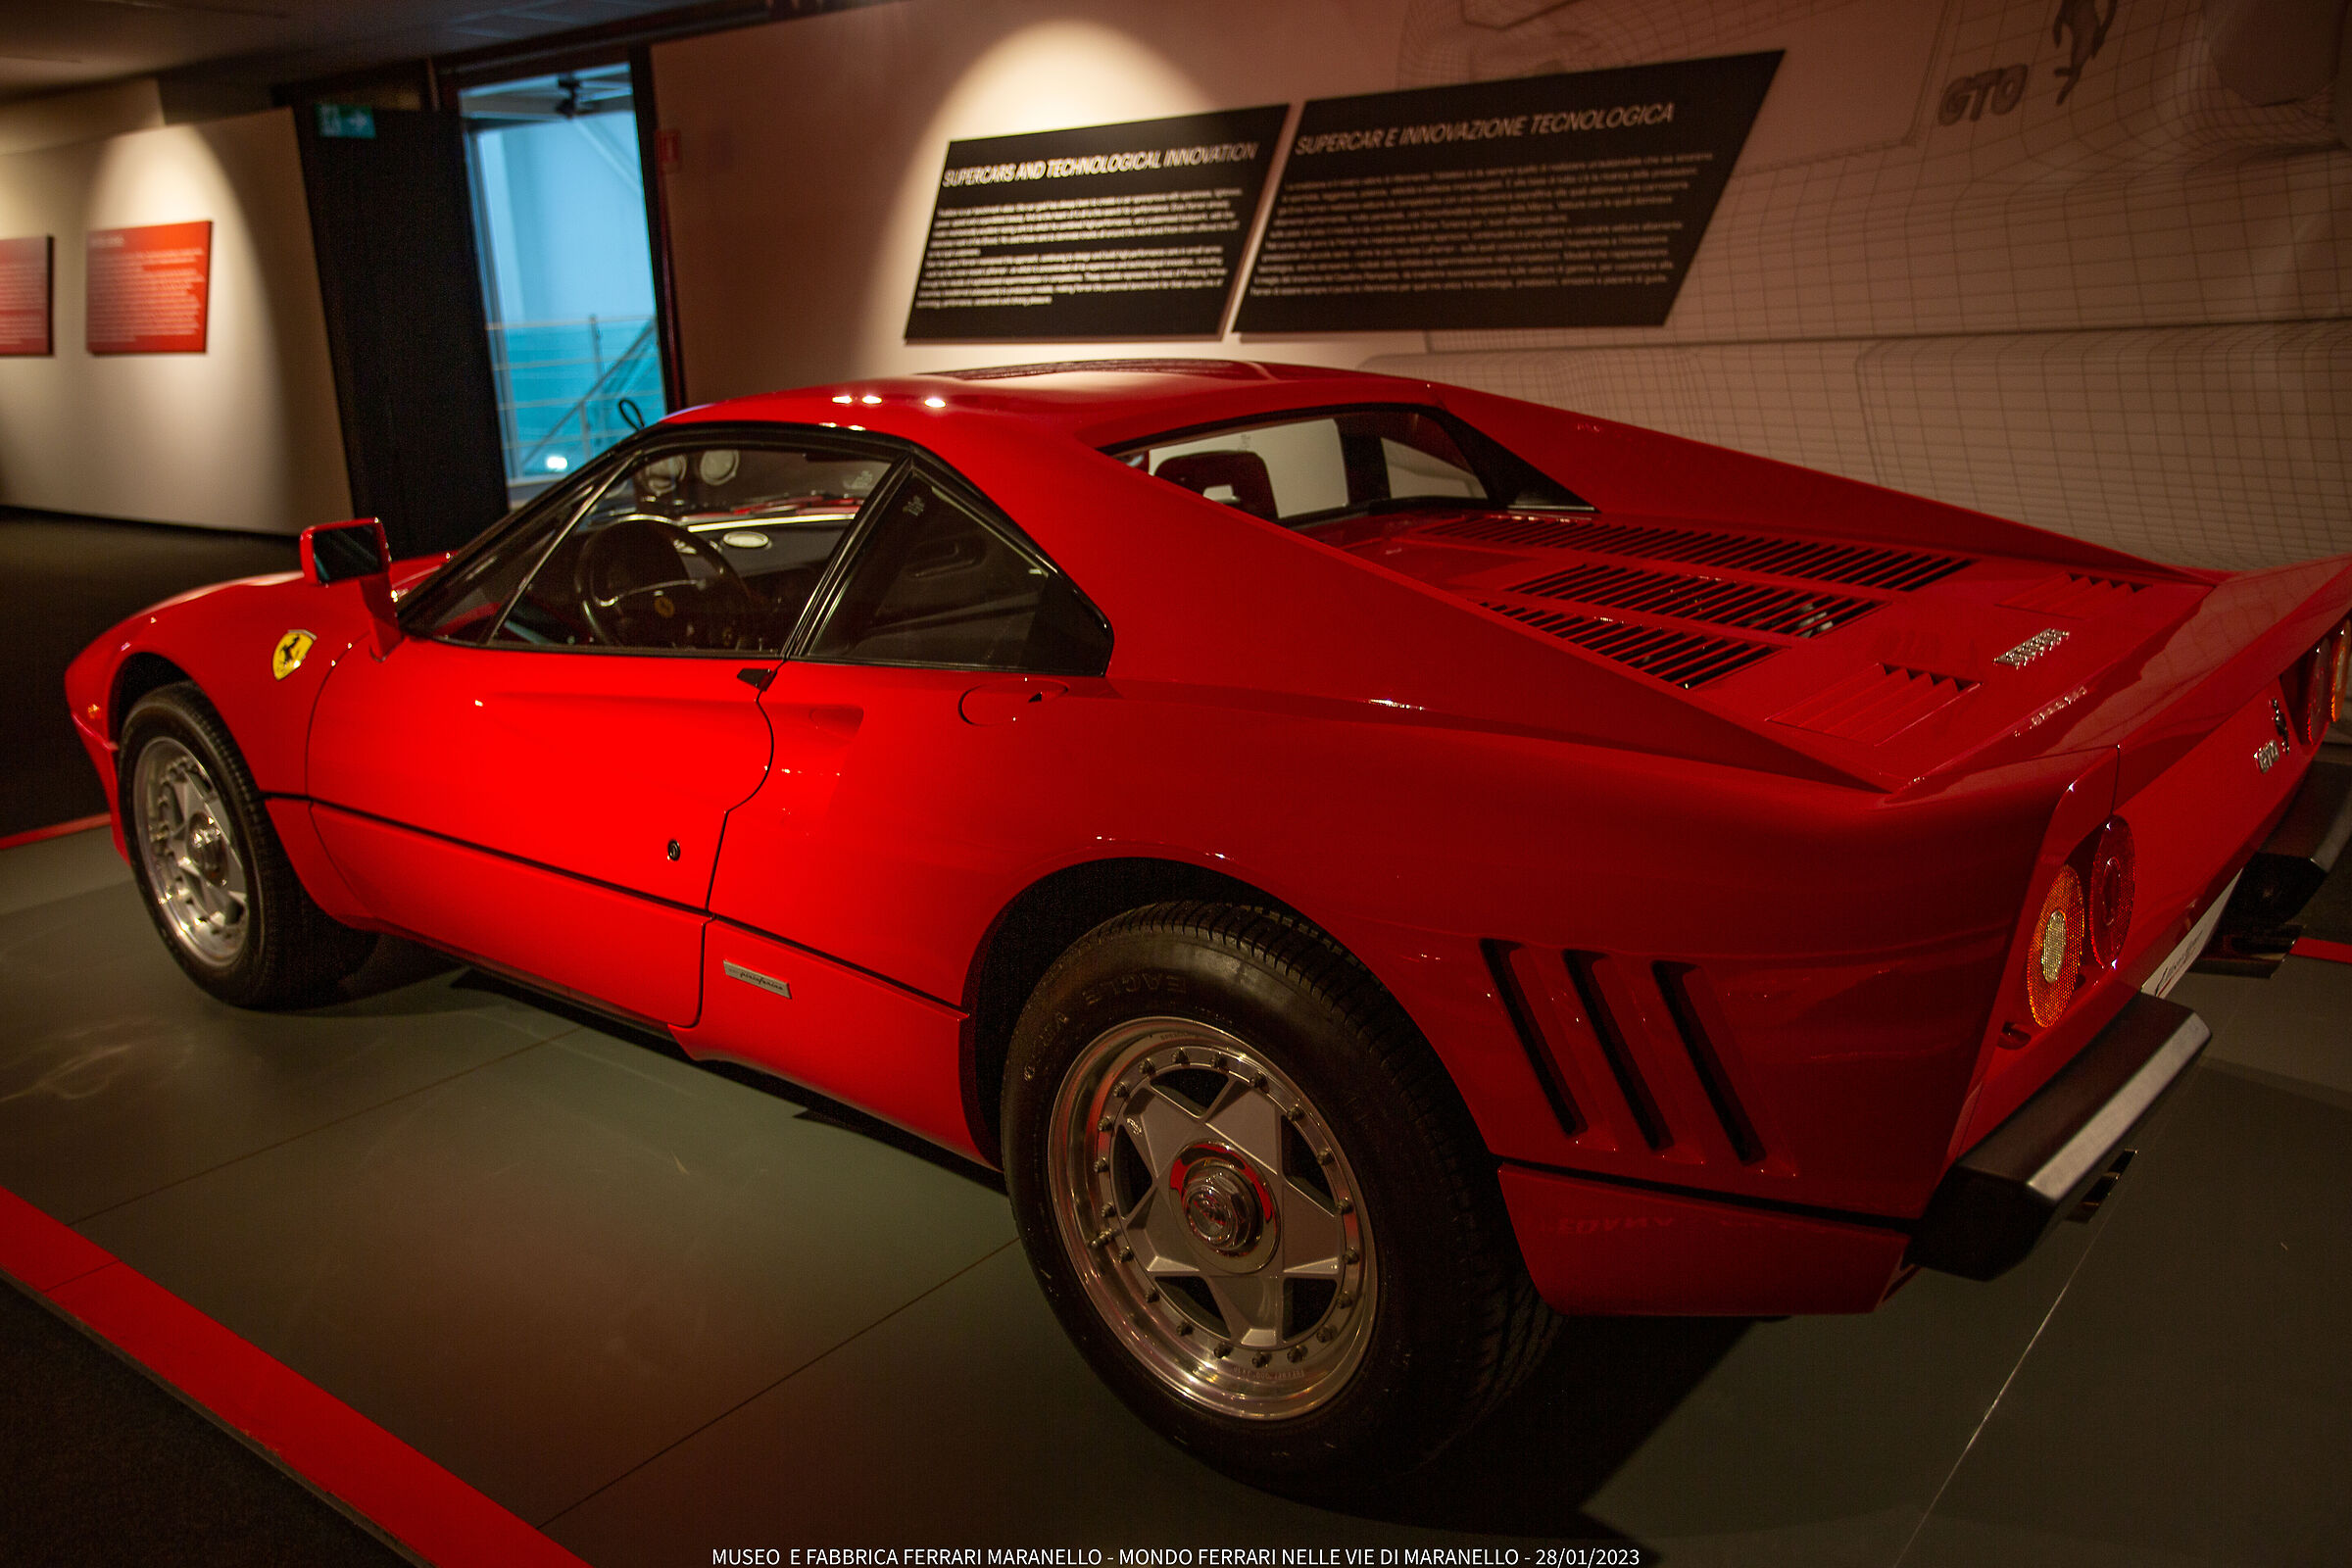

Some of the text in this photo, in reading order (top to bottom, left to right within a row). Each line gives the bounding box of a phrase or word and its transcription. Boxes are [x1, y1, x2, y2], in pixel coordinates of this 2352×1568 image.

[1938, 64, 2029, 126] GTO
[1295, 102, 1675, 155] SUPERCAR E INNOVAZIONE TECNOLOGICA
[942, 141, 1259, 187] SUPERCARS AND TECHNOLOGICAL INNOVATION
